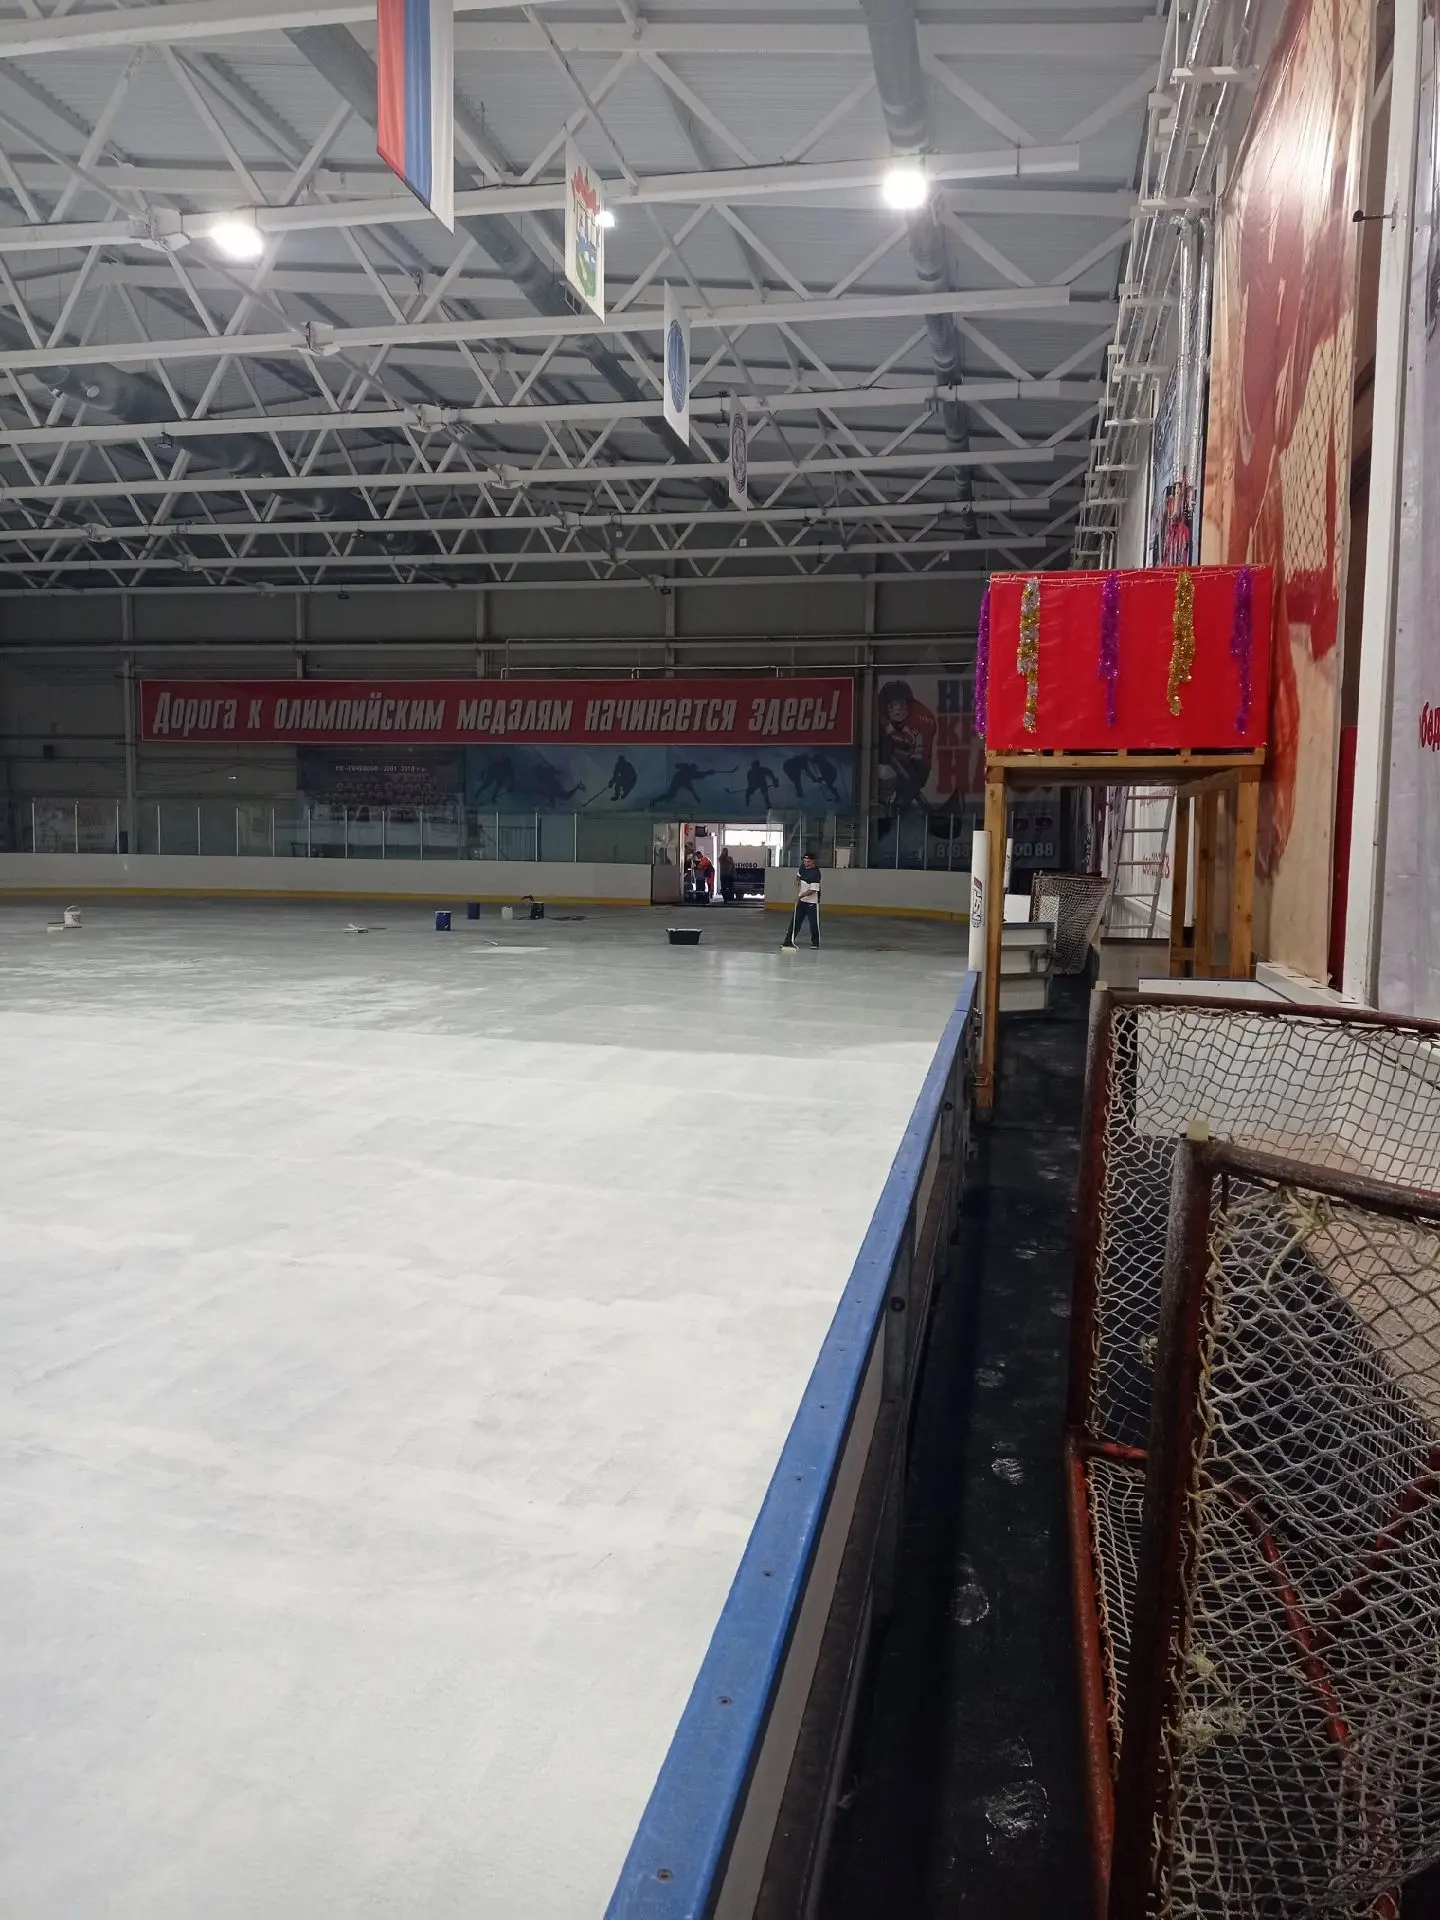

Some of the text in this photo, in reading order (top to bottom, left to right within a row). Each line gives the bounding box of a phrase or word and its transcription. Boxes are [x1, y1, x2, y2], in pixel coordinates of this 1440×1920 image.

[153, 690, 841, 736] Дорога к олимпийским медалям начинается здесь!
